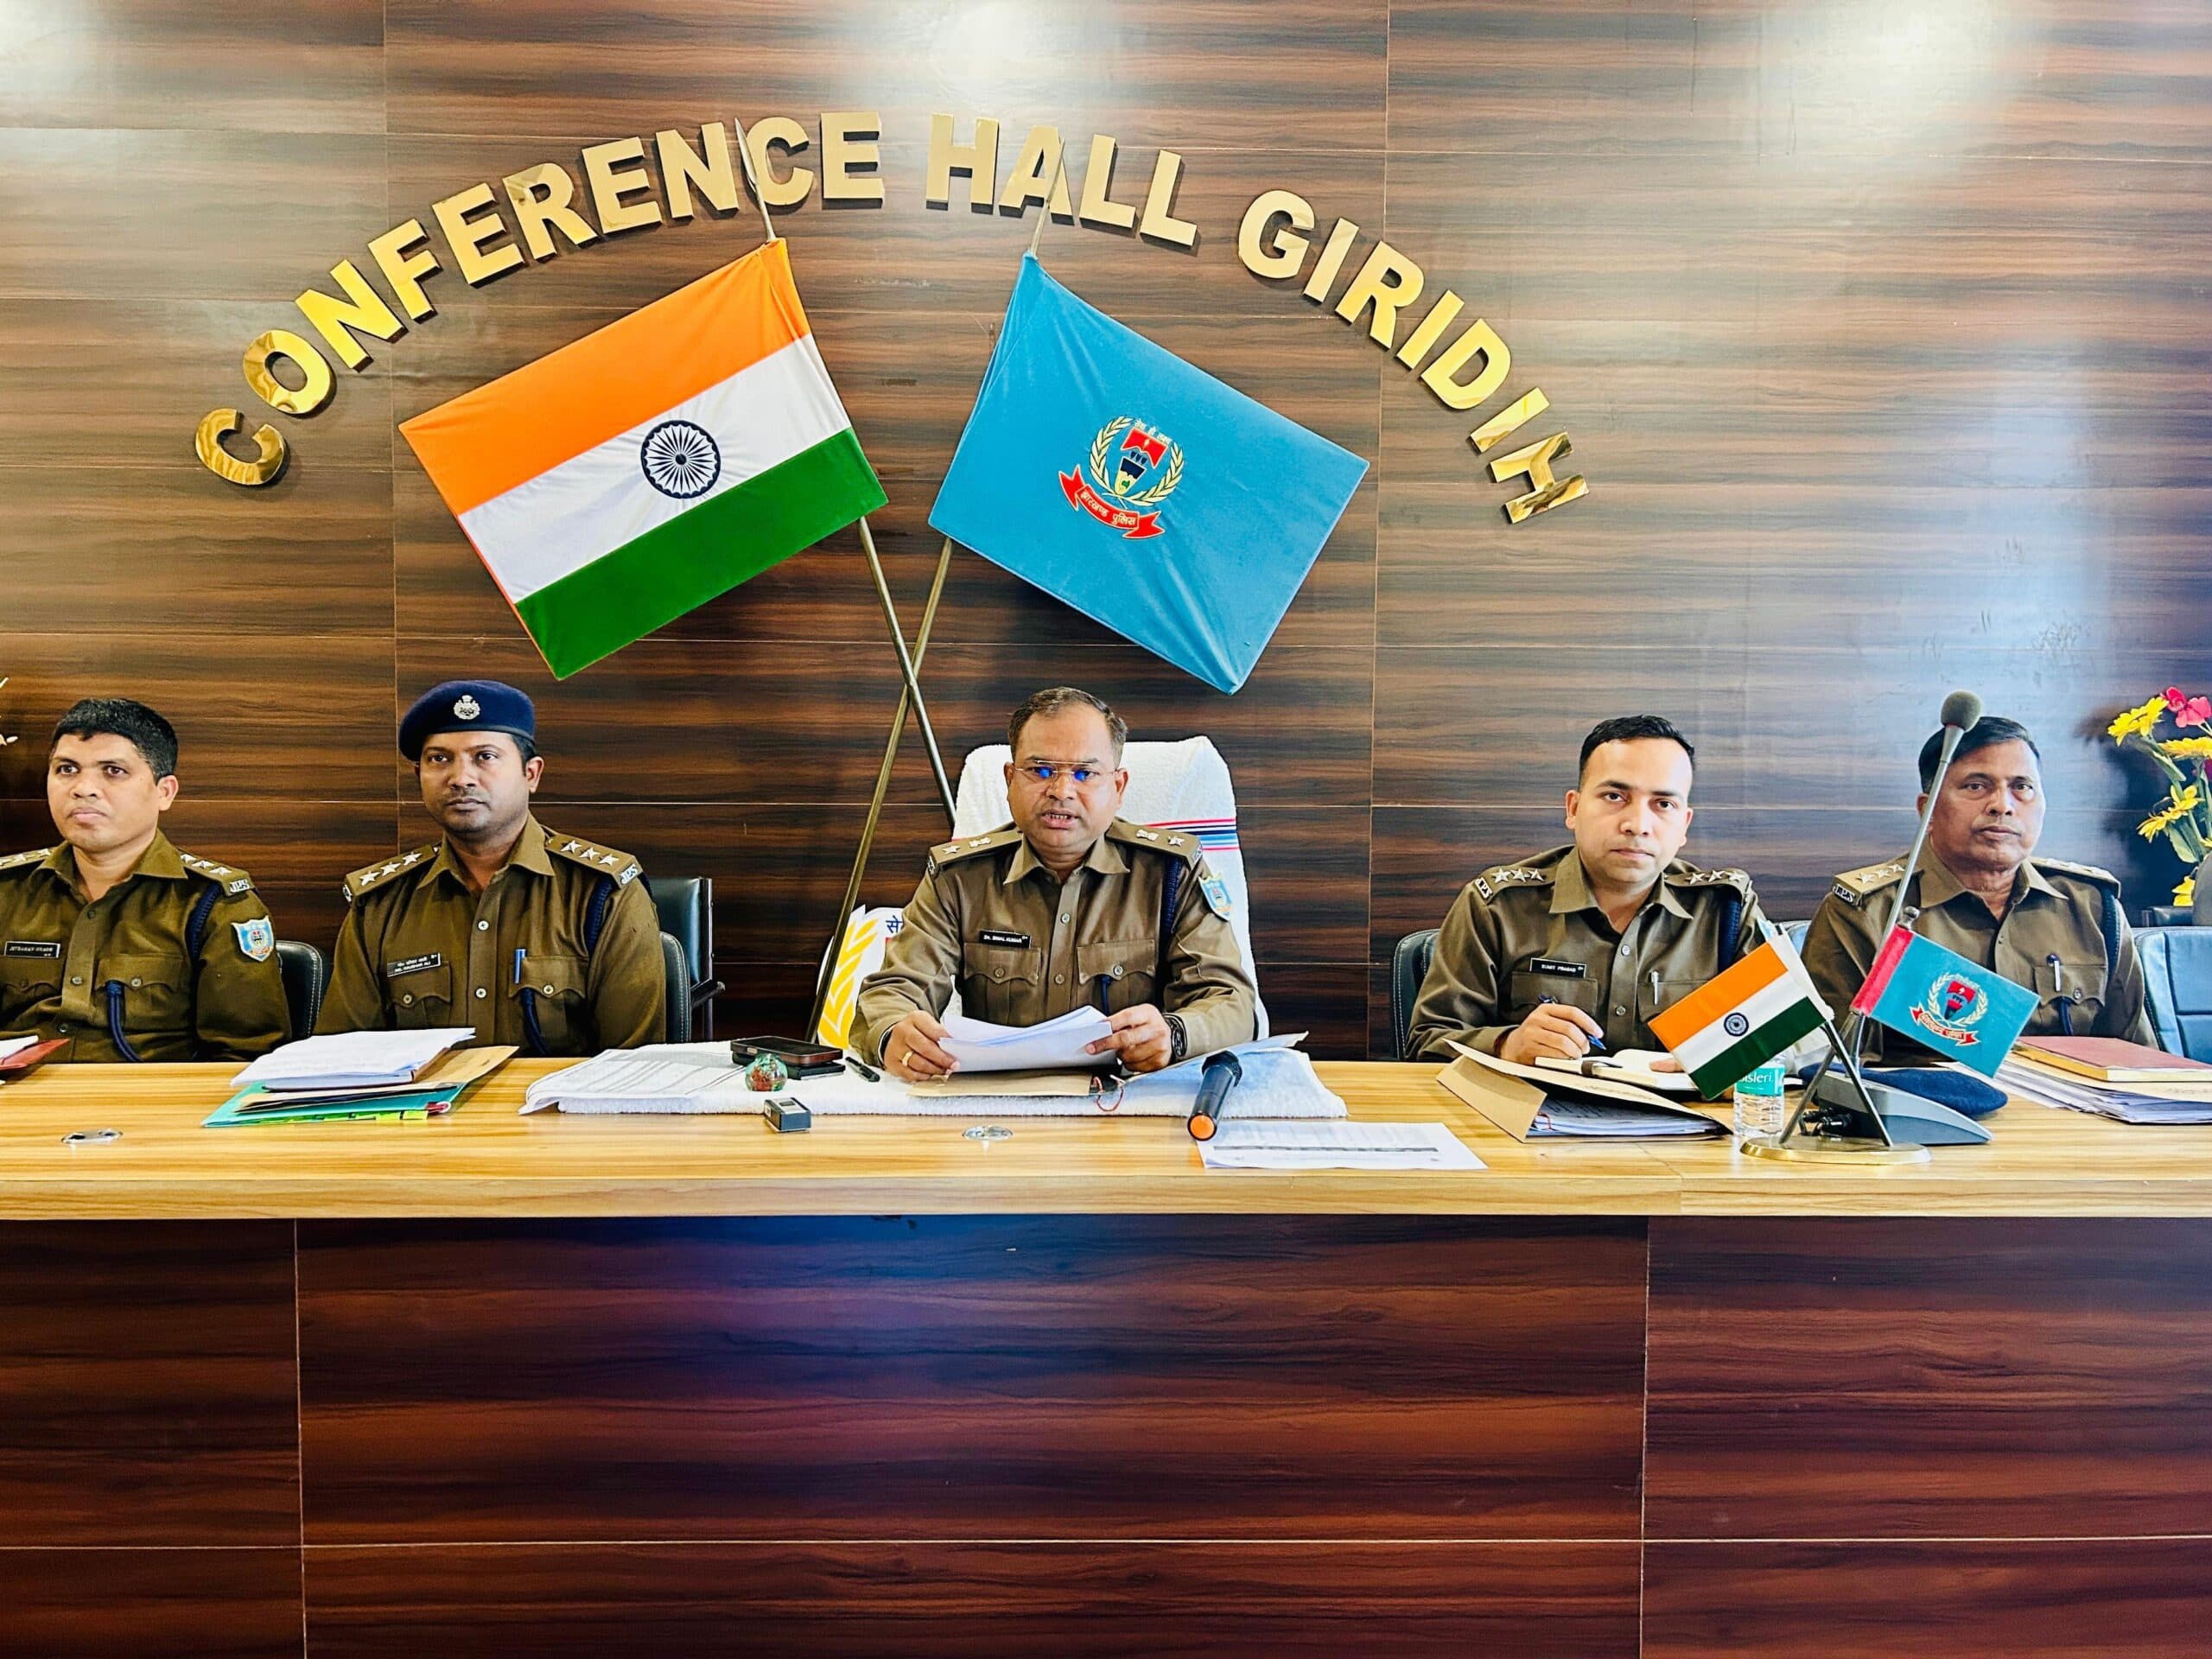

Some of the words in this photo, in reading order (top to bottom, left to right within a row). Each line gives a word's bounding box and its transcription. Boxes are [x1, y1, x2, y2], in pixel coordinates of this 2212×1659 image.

[194, 111, 885, 486] CONFERENCE
[926, 112, 1198, 249] HALL
[1238, 189, 1590, 524] GIRIDIH
[1111, 512, 1135, 525] पुलिस
